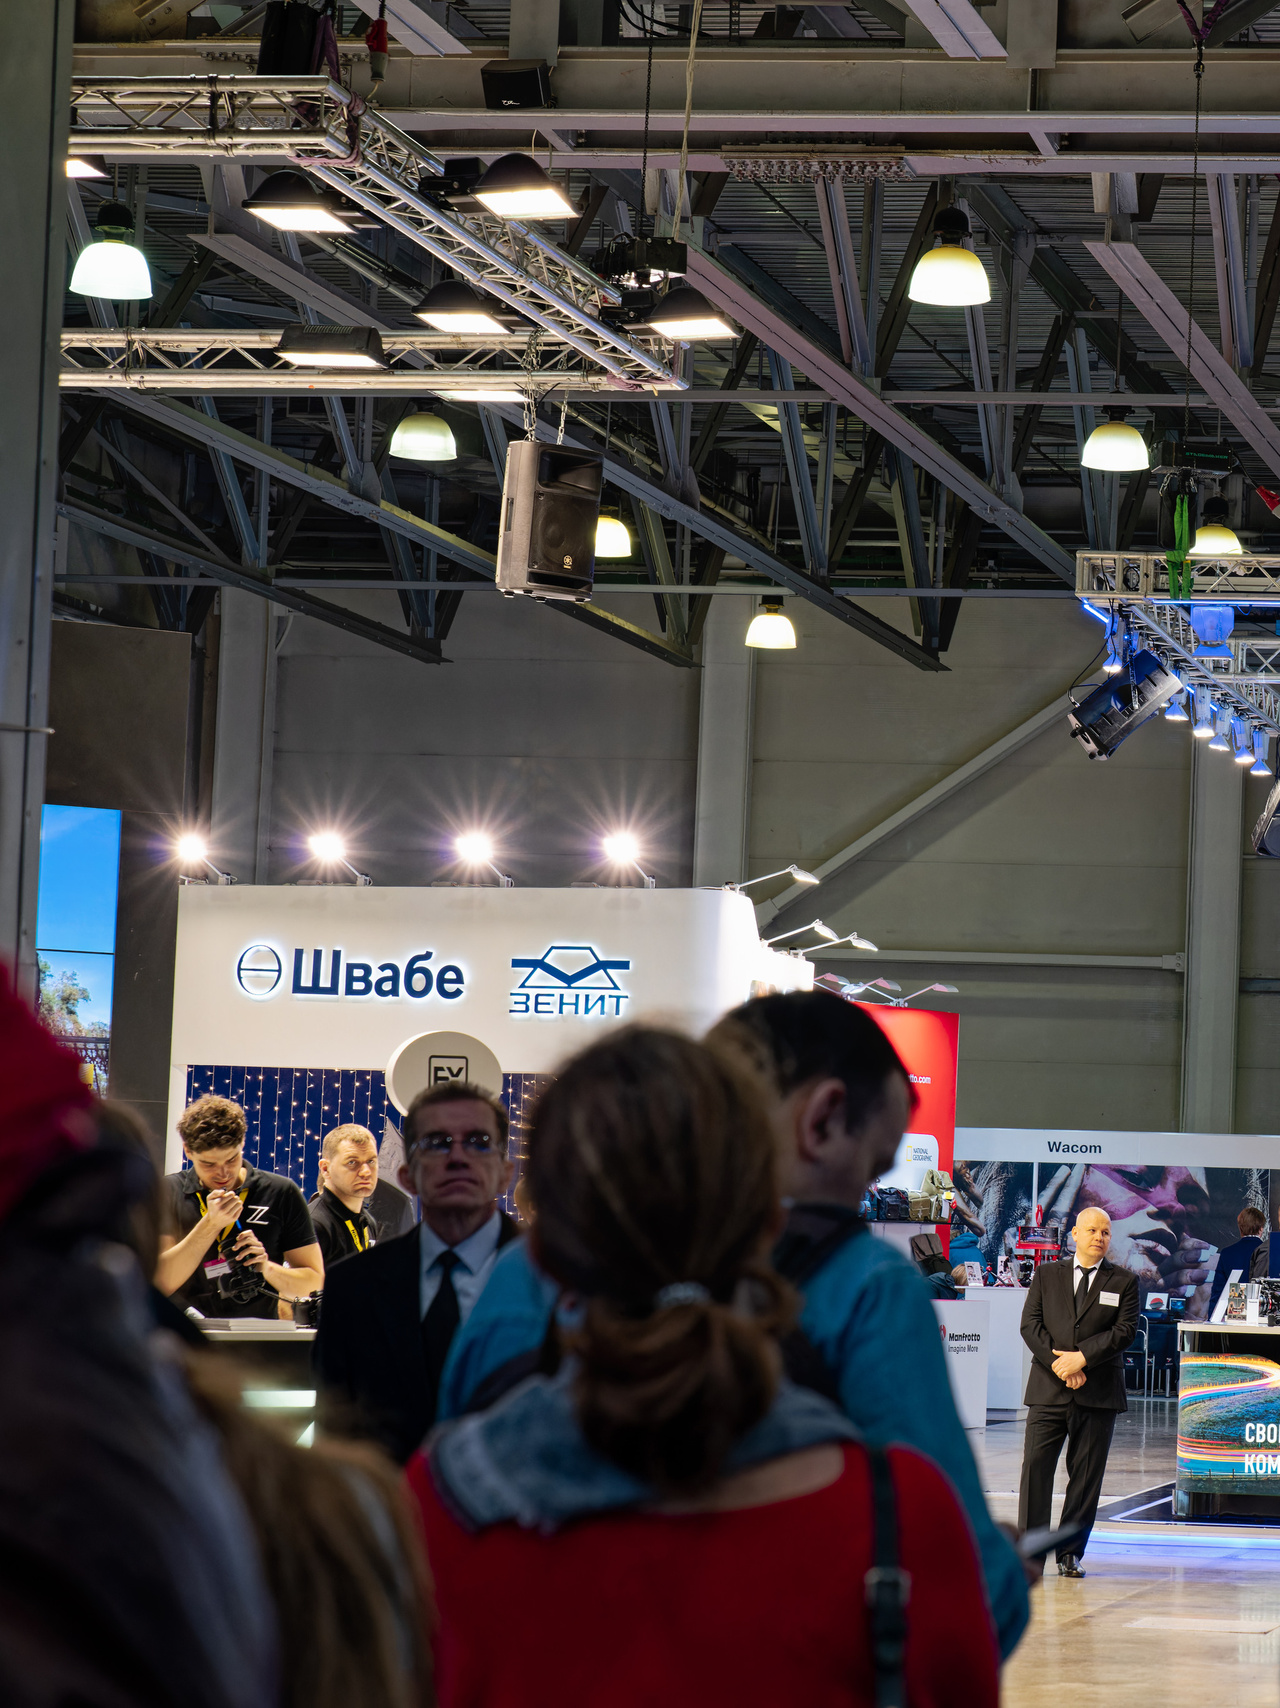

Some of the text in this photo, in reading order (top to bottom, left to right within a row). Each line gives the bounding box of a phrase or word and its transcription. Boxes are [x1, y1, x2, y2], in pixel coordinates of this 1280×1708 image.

[292, 947, 465, 1000] Швабе
[509, 992, 629, 1016] ЗЕНИТ
[1047, 1141, 1102, 1154] Wacom
[948, 1333, 981, 1342] Manfrotto
[948, 1345, 979, 1355] Imagine More
